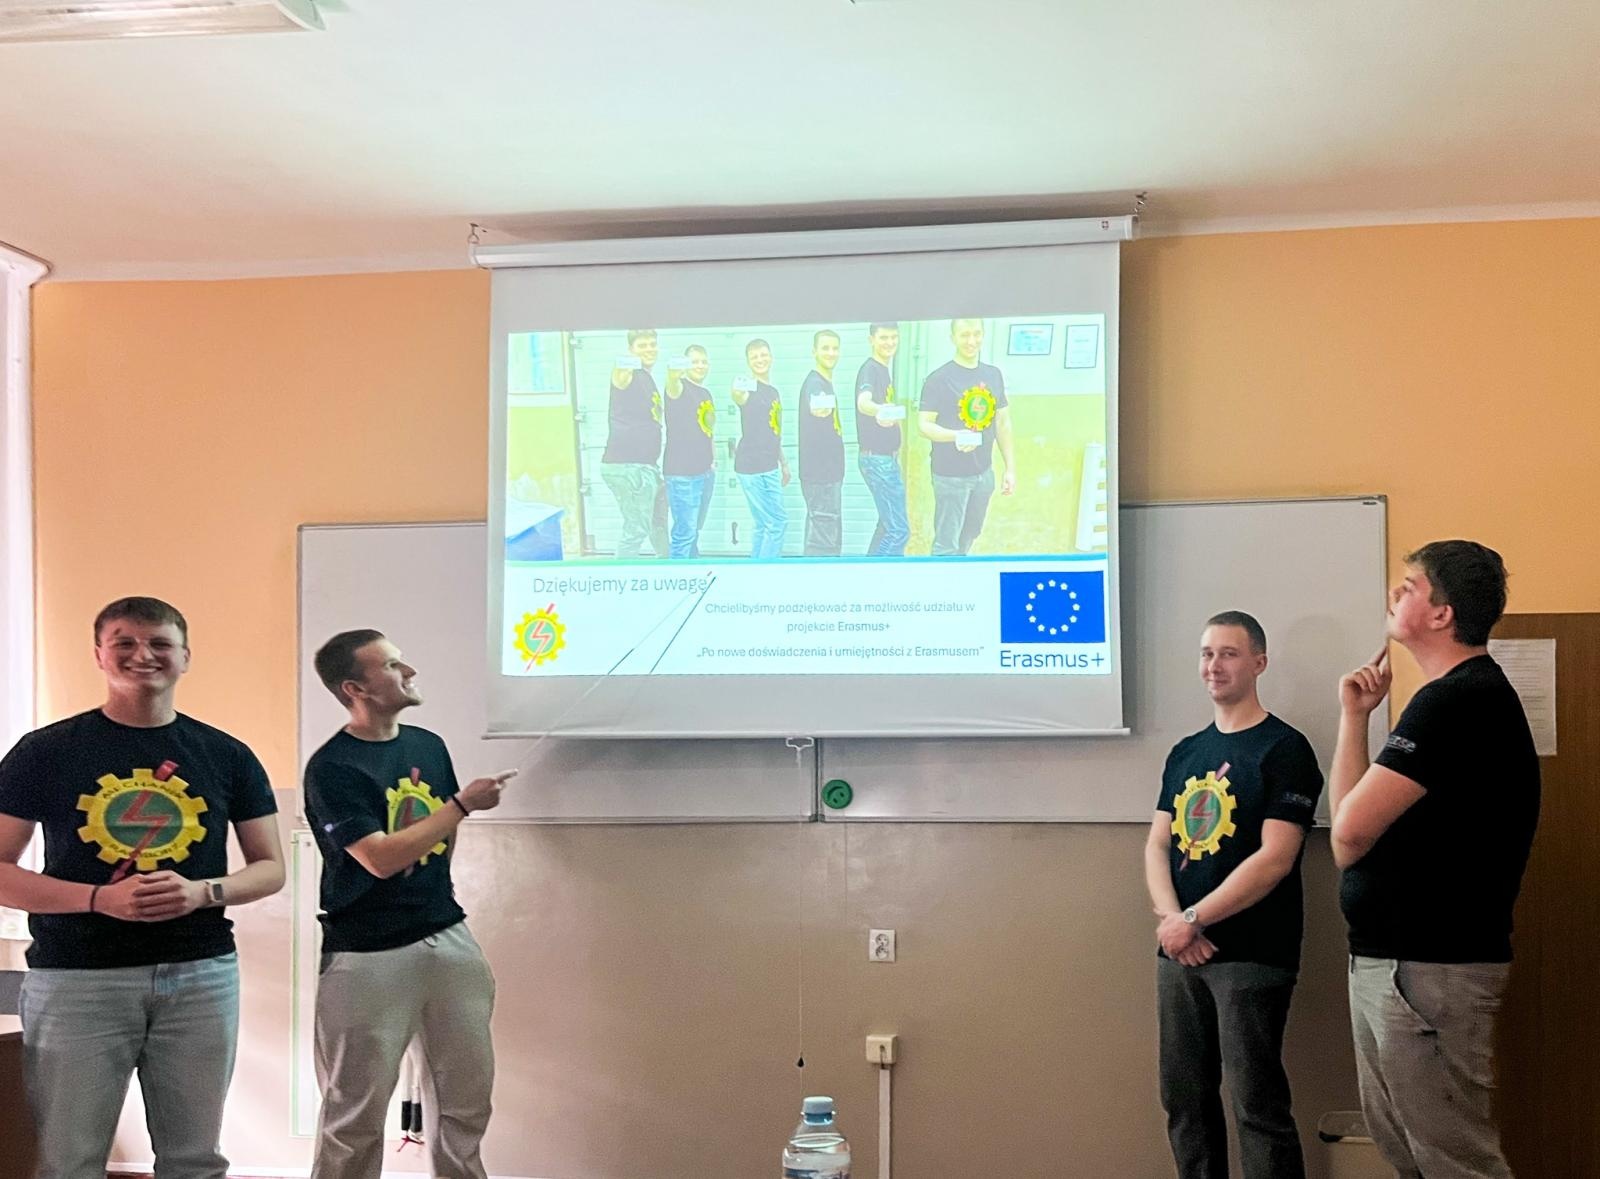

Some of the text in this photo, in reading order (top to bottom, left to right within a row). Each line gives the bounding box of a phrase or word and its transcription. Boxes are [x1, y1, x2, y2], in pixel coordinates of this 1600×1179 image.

[533, 575, 708, 596] Dziękujemy za uwagę
[704, 601, 975, 615] Chcielibyśmy podziękować za możliwość udziału w
[787, 621, 890, 633] projekcie Erasmus+
[717, 648, 746, 657] nowe
[748, 646, 827, 657] doświadczenia
[835, 645, 904, 659] umiejętności
[907, 648, 912, 656] z
[1000, 650, 1105, 668] Erasmus+
